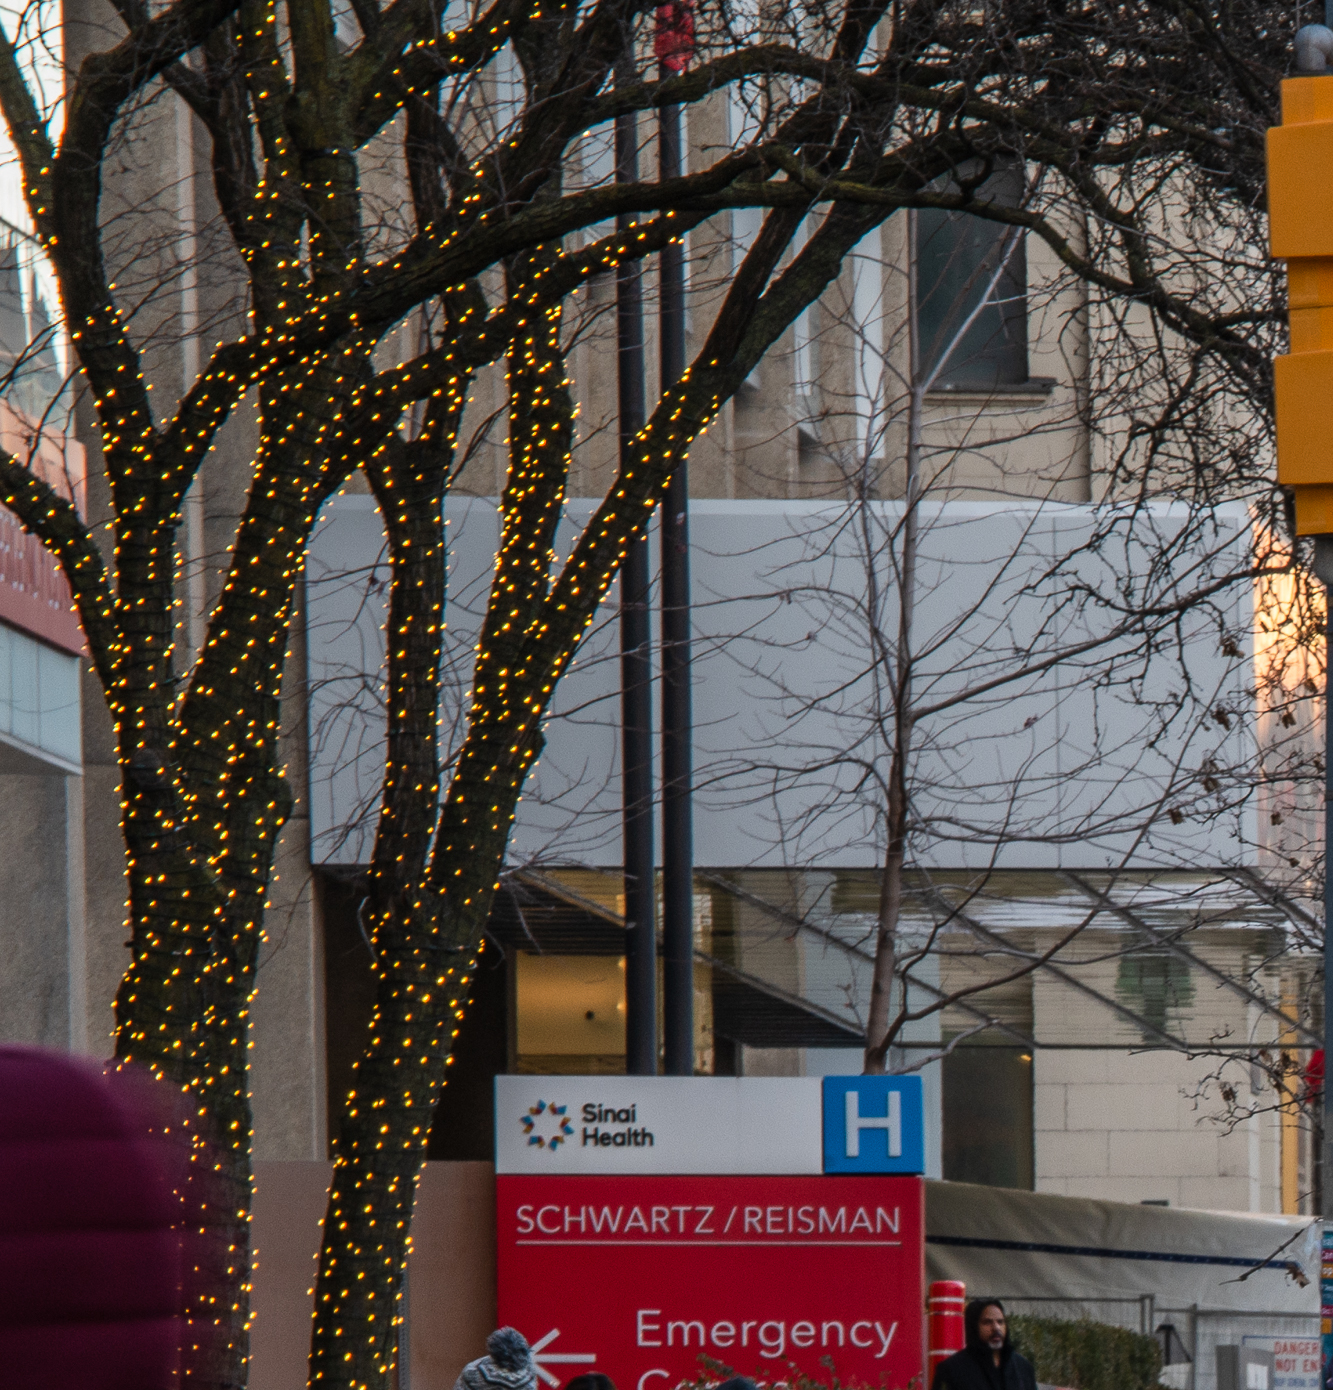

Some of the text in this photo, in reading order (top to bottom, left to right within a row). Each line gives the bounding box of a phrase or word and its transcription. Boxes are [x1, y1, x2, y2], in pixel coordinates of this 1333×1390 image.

[582, 1103, 636, 1124] Sinai
[845, 1091, 902, 1157] H
[582, 1127, 654, 1147] Health
[516, 1205, 714, 1234] SCHWARTZ
[744, 1205, 900, 1234] REISMAN
[636, 1309, 899, 1359] Emergency
[1274, 1341, 1318, 1355] DANGER
[1275, 1358, 1296, 1372] NOT
